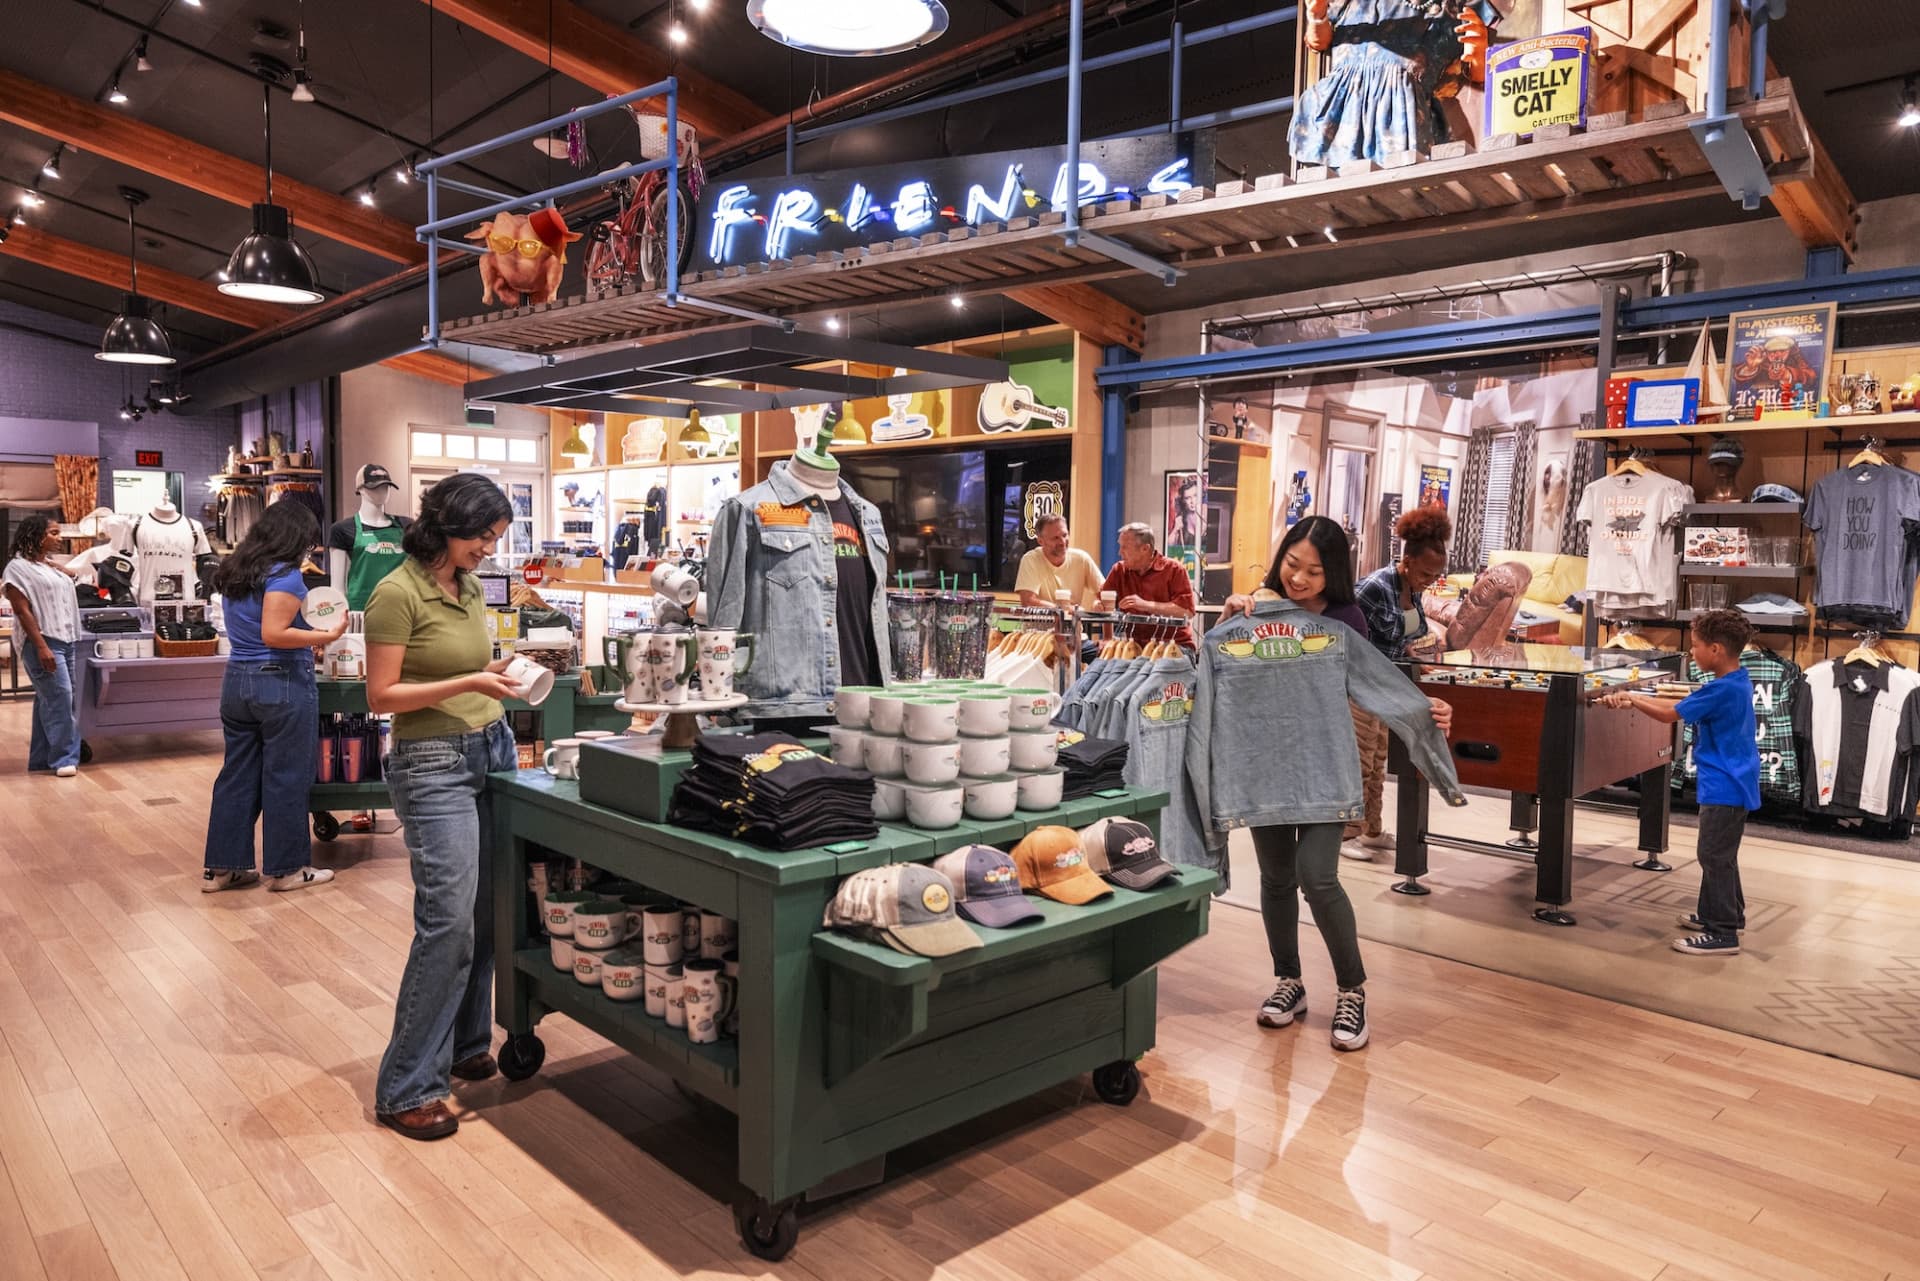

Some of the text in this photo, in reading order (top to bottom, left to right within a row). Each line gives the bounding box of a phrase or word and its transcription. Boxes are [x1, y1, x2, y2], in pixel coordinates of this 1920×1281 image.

[1500, 66, 1573, 97] SMELLY
[1513, 89, 1557, 118] CAT
[1532, 114, 1575, 128] CAT LITTER
[138, 453, 160, 465] EXIT
[1035, 496, 1052, 519] 30
[1602, 495, 1648, 506] INSIDE
[1846, 496, 1876, 515] HOW
[1607, 507, 1640, 517] GOOD
[1847, 515, 1870, 533] YOU
[525, 569, 542, 580] SALE
[1253, 622, 1299, 640] CENTRAL
